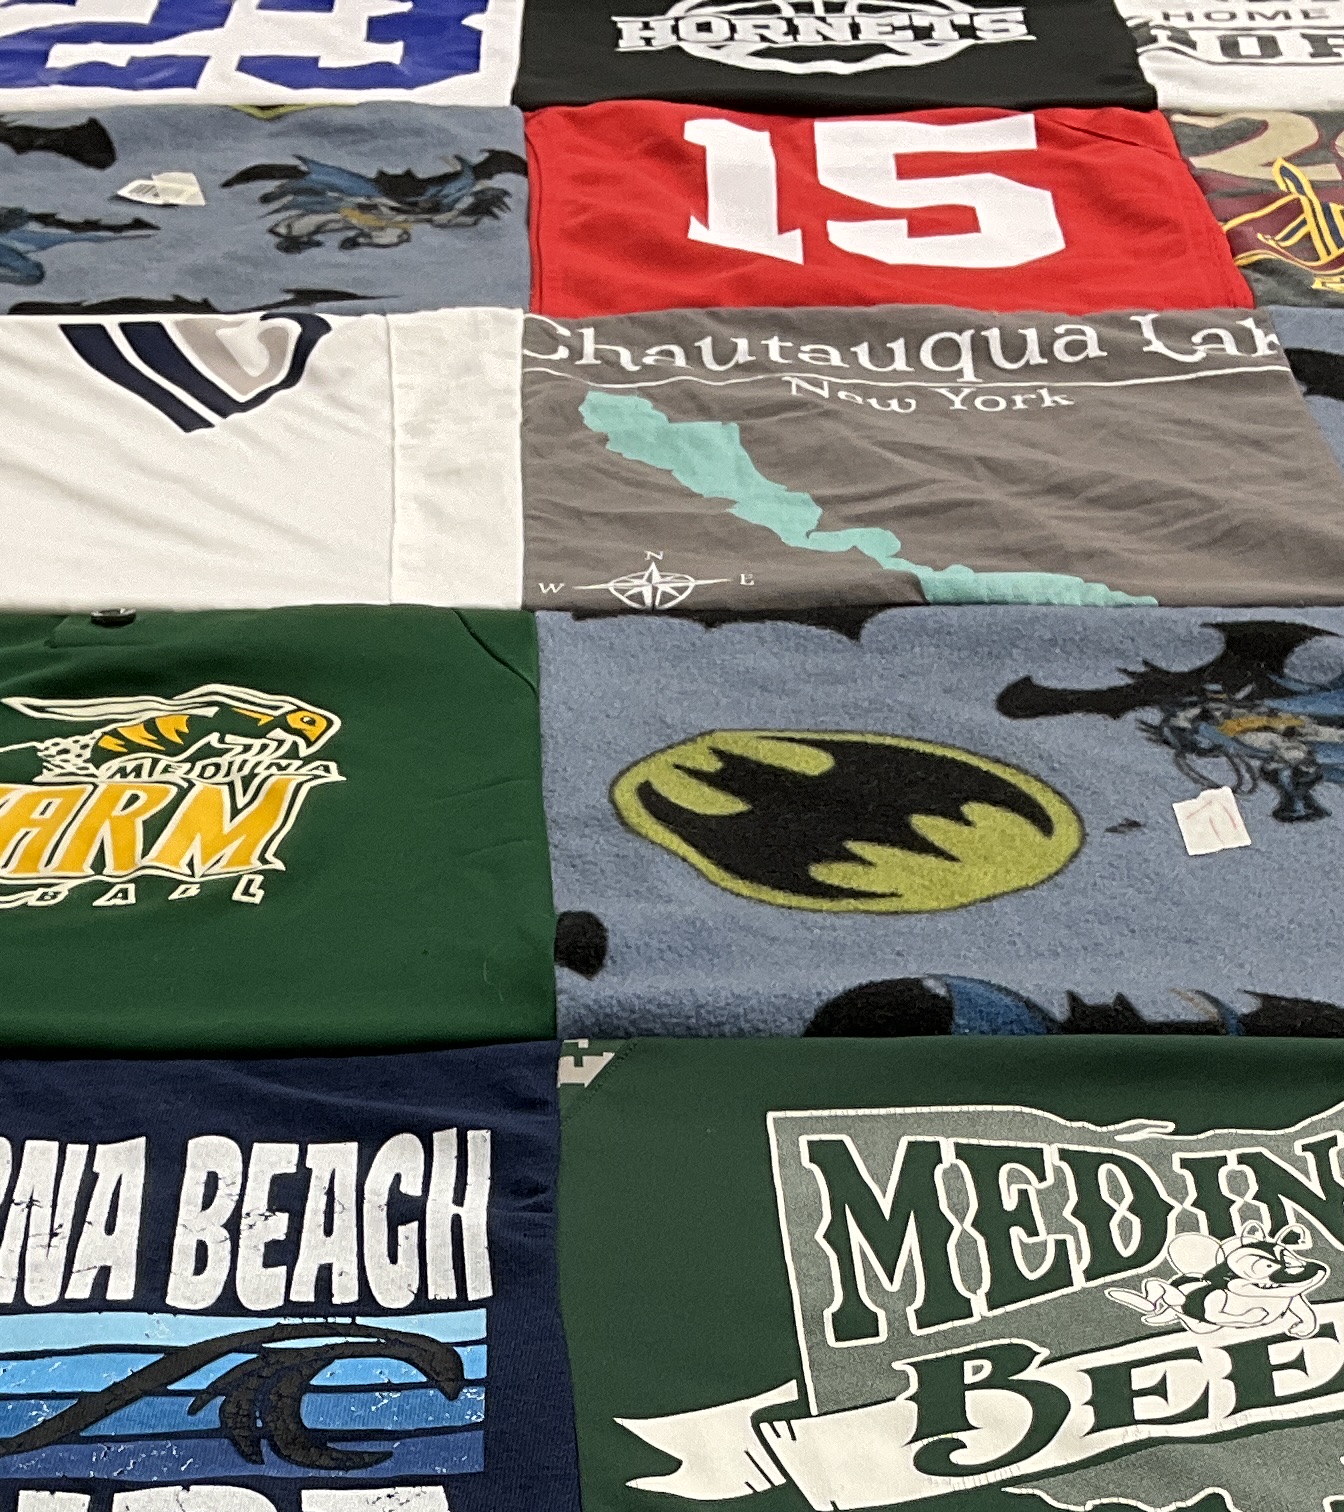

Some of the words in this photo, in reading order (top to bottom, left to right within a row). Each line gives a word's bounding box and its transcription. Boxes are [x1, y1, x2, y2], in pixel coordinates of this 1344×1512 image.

[613, 6, 1037, 51] HORNETS
[1162, 9, 1329, 21] HOME
[683, 114, 1066, 268] 15
[524, 313, 1107, 382] Chautauqua
[782, 377, 918, 413] New
[936, 386, 1075, 412] York
[538, 582, 564, 595] W
[739, 573, 755, 587] E
[96, 757, 346, 782] MEDINA
[165, 1127, 494, 1313] BEACH
